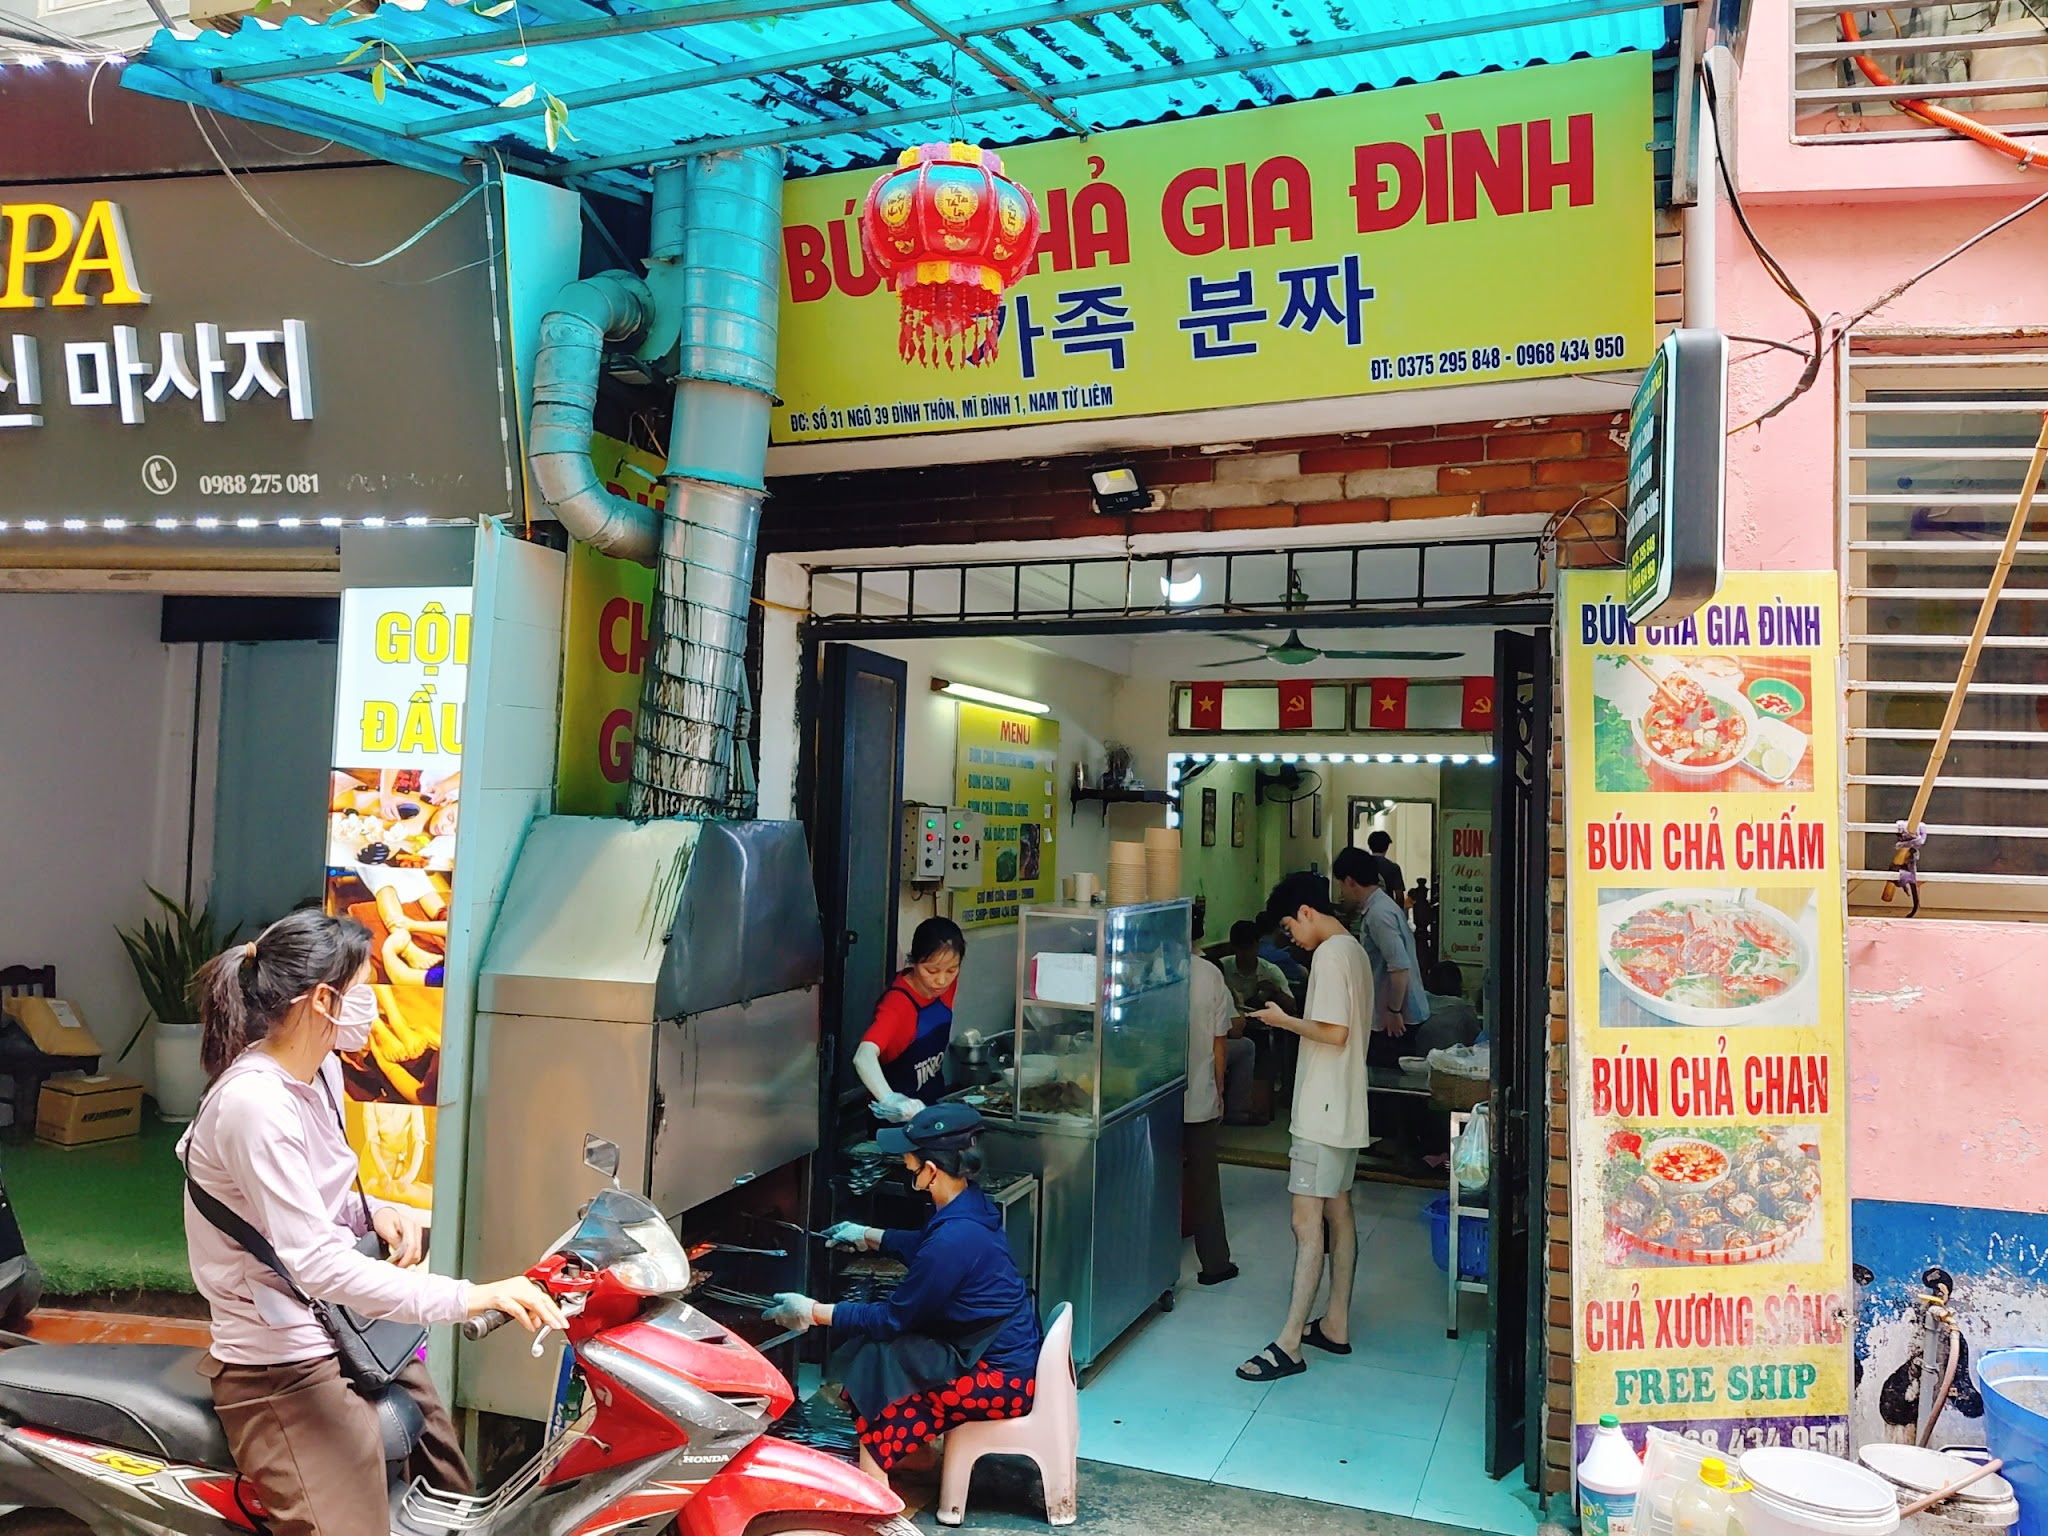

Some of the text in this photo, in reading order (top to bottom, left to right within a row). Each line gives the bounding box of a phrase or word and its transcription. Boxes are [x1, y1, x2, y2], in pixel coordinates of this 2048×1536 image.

[783, 112, 1595, 303] BÚ HẢ GIA ĐÌNH
[0, 200, 152, 308] PA
[1179, 253, 1376, 360] 분짜
[64, 318, 314, 425] 마사지
[1371, 358, 1393, 380] ĐT:
[1397, 354, 1434, 378] 0375
[1439, 351, 1467, 374] 295
[1472, 347, 1500, 370] 848
[1516, 342, 1555, 366] 0968
[1560, 339, 1589, 362] 434
[1595, 335, 1624, 358] 950
[790, 383, 1113, 432] ĐC: SỐ 31 NGÕ 39 ĐÌNH THÔN, MĨ ĐÌNH 1, NAM TỪ LIÊM
[199, 474, 247, 495] 0988
[250, 474, 283, 494] 275
[286, 473, 319, 494] 081
[1581, 595, 1636, 645] BÚN
[1707, 605, 1751, 646] GIA
[1758, 596, 1821, 646] ĐÌNH
[1000, 720, 1031, 745] MENU
[1452, 823, 1484, 857] BÚN
[1587, 805, 1825, 870] BÚN CHẢ CHẤM
[1592, 1035, 1829, 1117] BÚN CHẢ CHAN
[1585, 1283, 1844, 1352] CHẢ XƯƠNG SÔNG
[1614, 1363, 1817, 1406] FREE SHIP
[683, 1454, 730, 1464] HONDA
[1791, 1425, 1846, 1456] 950
